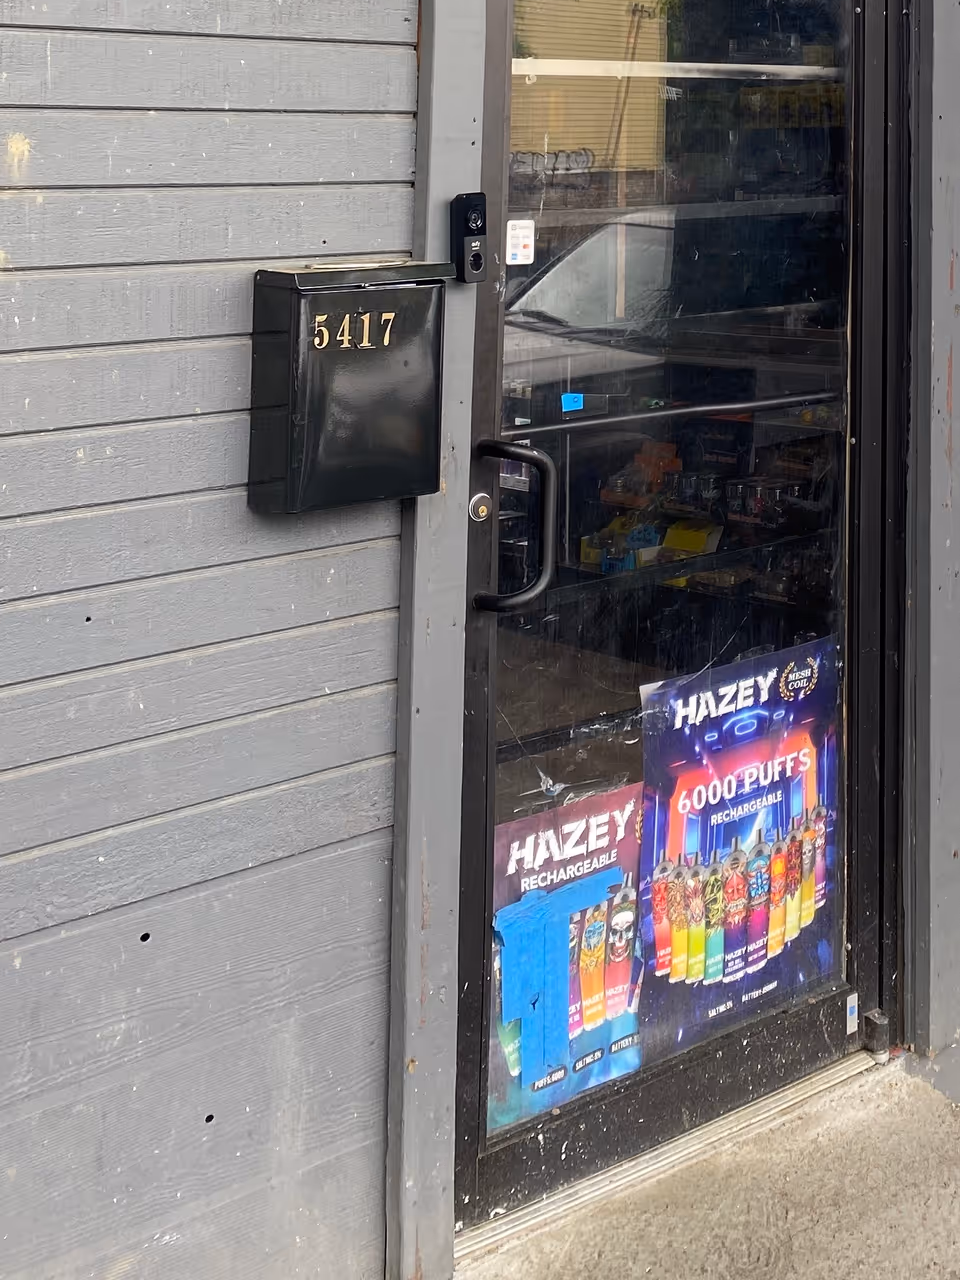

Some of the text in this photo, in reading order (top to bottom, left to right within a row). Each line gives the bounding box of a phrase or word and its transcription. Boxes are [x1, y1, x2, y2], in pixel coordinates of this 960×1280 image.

[313, 312, 396, 350] 5417
[788, 668, 812, 682] MESH
[788, 679, 809, 690] COIL
[673, 666, 779, 730] HAZEY
[677, 748, 812, 815] 6000 PUFFS
[711, 790, 782, 826] RECHARGEABLE
[504, 797, 636, 877] HAZEY
[520, 849, 618, 893] RECHARGEABLE
[725, 945, 747, 962] HAZEY
